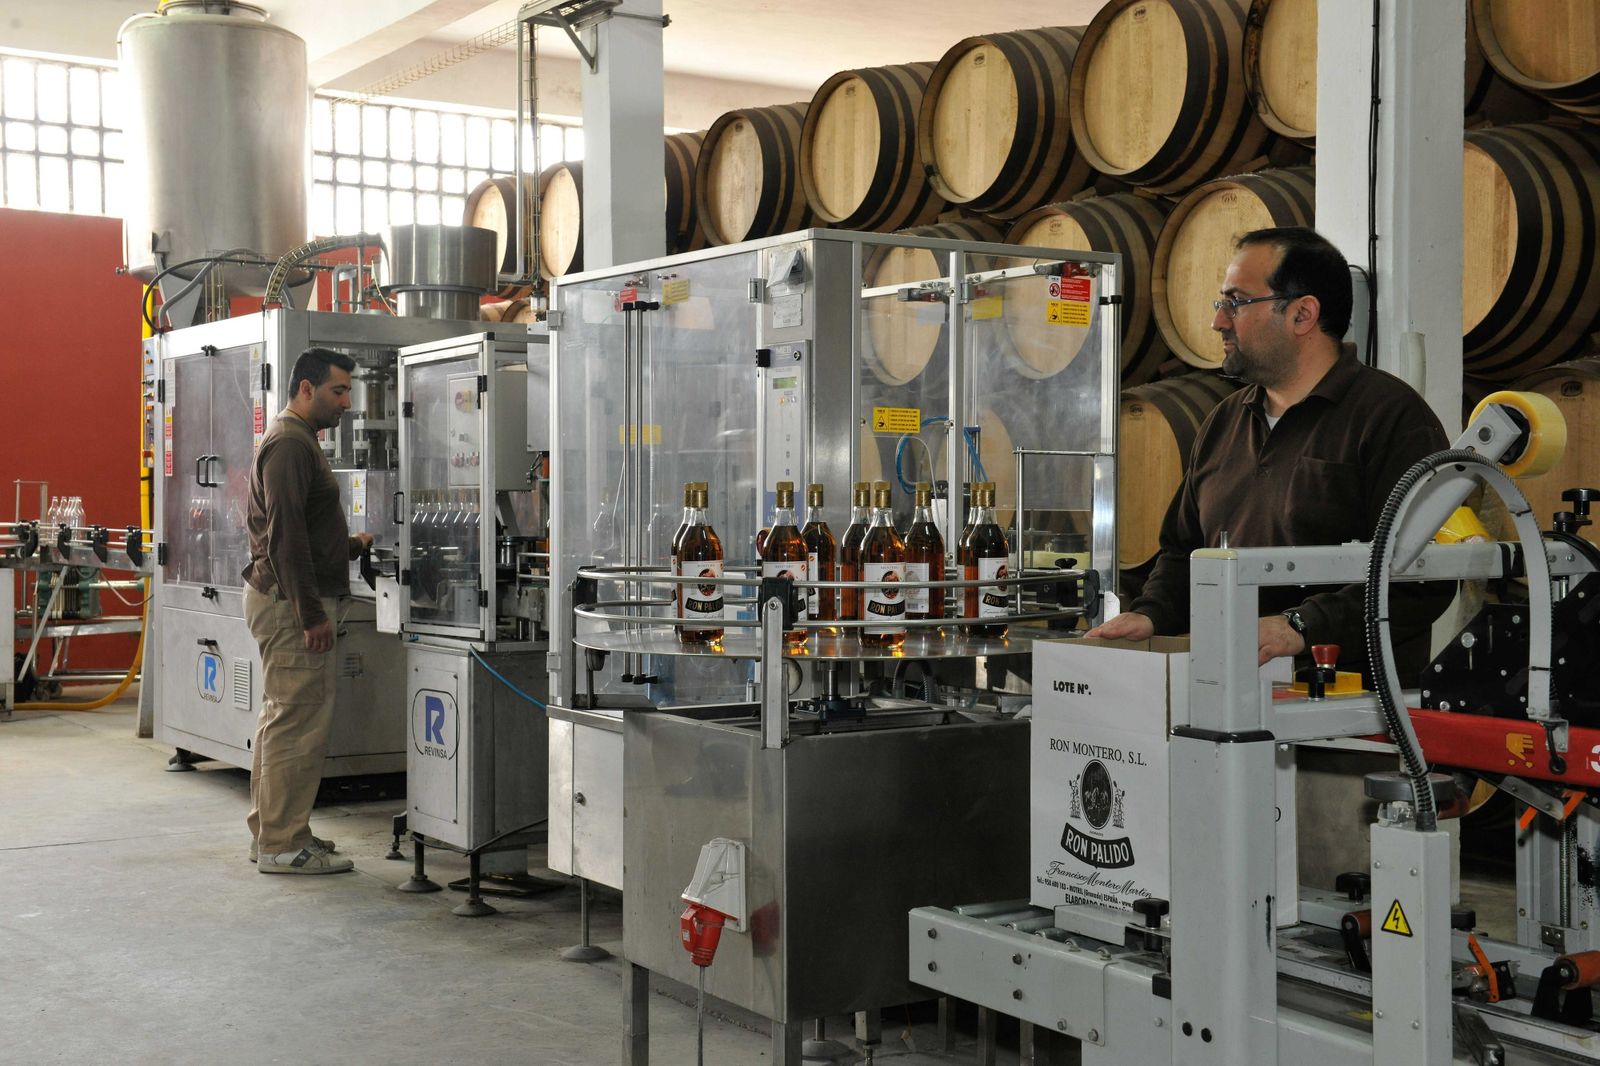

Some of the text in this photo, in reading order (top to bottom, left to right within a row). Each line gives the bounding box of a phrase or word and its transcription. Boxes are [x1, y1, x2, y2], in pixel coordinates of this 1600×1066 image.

[870, 602, 886, 615] RON
[1053, 680, 1075, 694] LOTE
[424, 745, 448, 760] REVINSA
[1049, 738, 1148, 767] RON MONTERO, S.L.
[1066, 829, 1130, 864] RON PALIDO
[1046, 860, 1088, 881] Francisco
[1087, 871, 1122, 894] Montero
